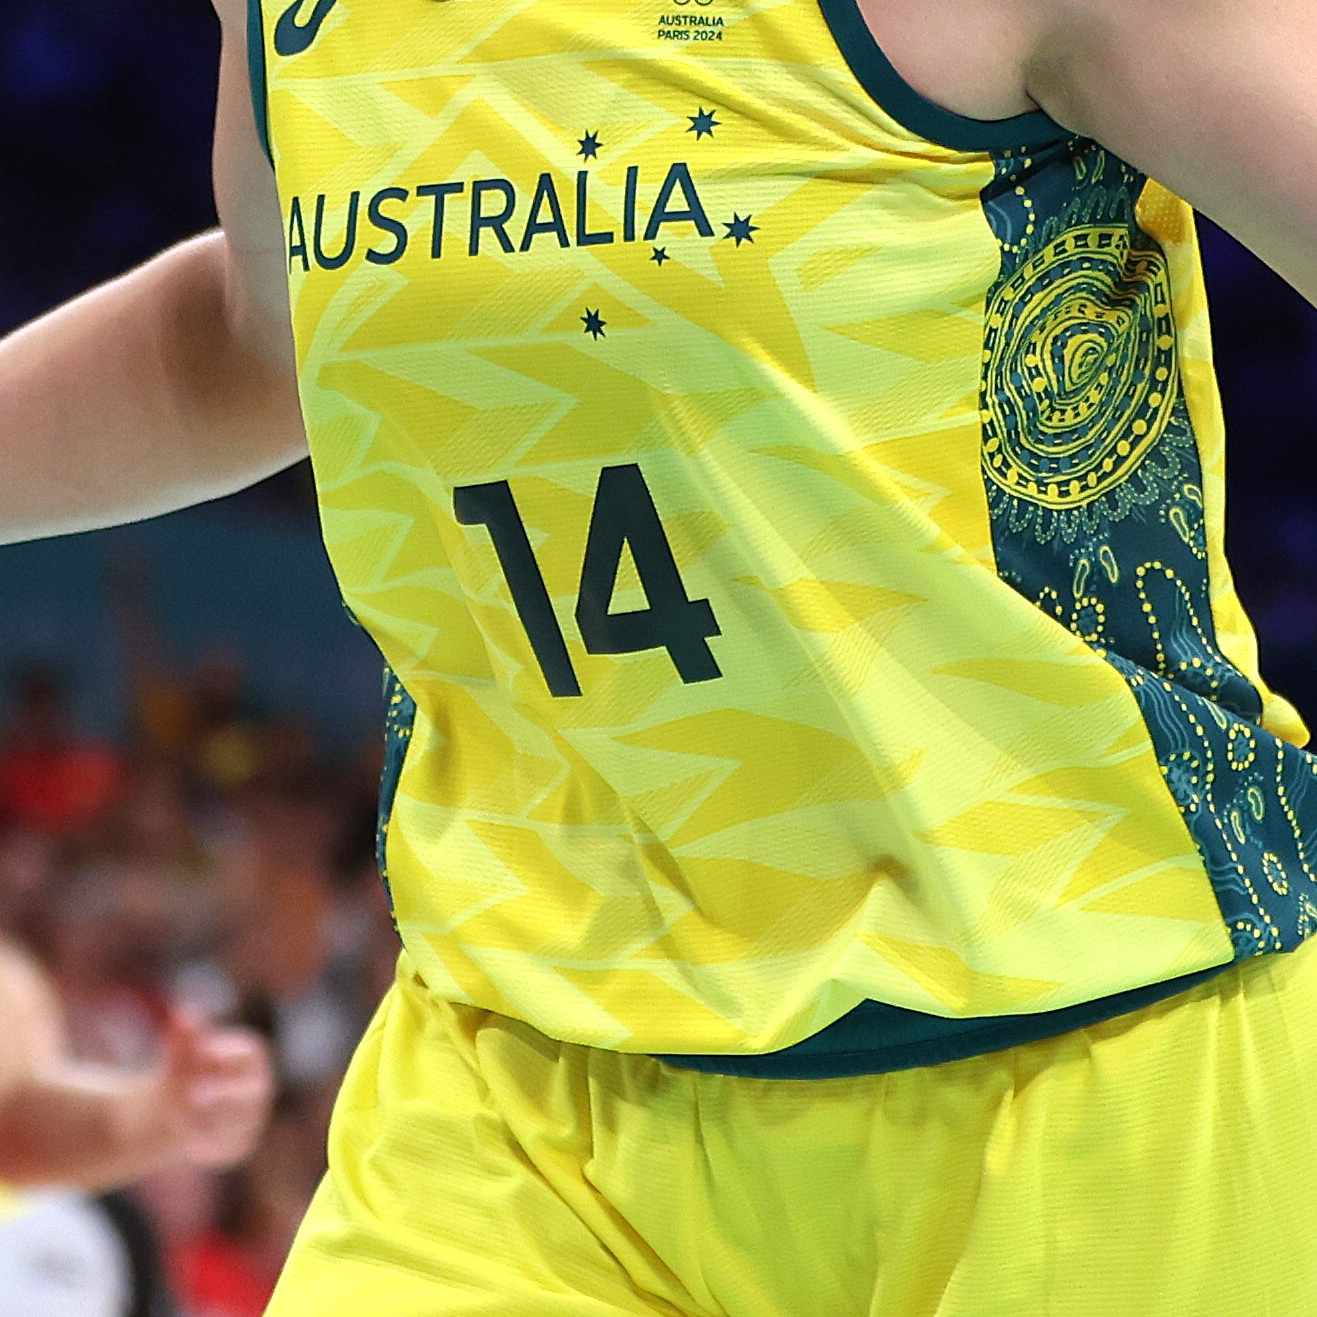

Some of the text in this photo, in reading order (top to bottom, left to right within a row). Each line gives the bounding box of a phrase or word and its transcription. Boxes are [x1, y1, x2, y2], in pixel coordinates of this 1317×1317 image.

[657, 29, 723, 41] PARIS 2024
[658, 15, 724, 26] AUSTRALIA
[287, 162, 715, 275] AUSTRALIA
[453, 463, 723, 697] 14
